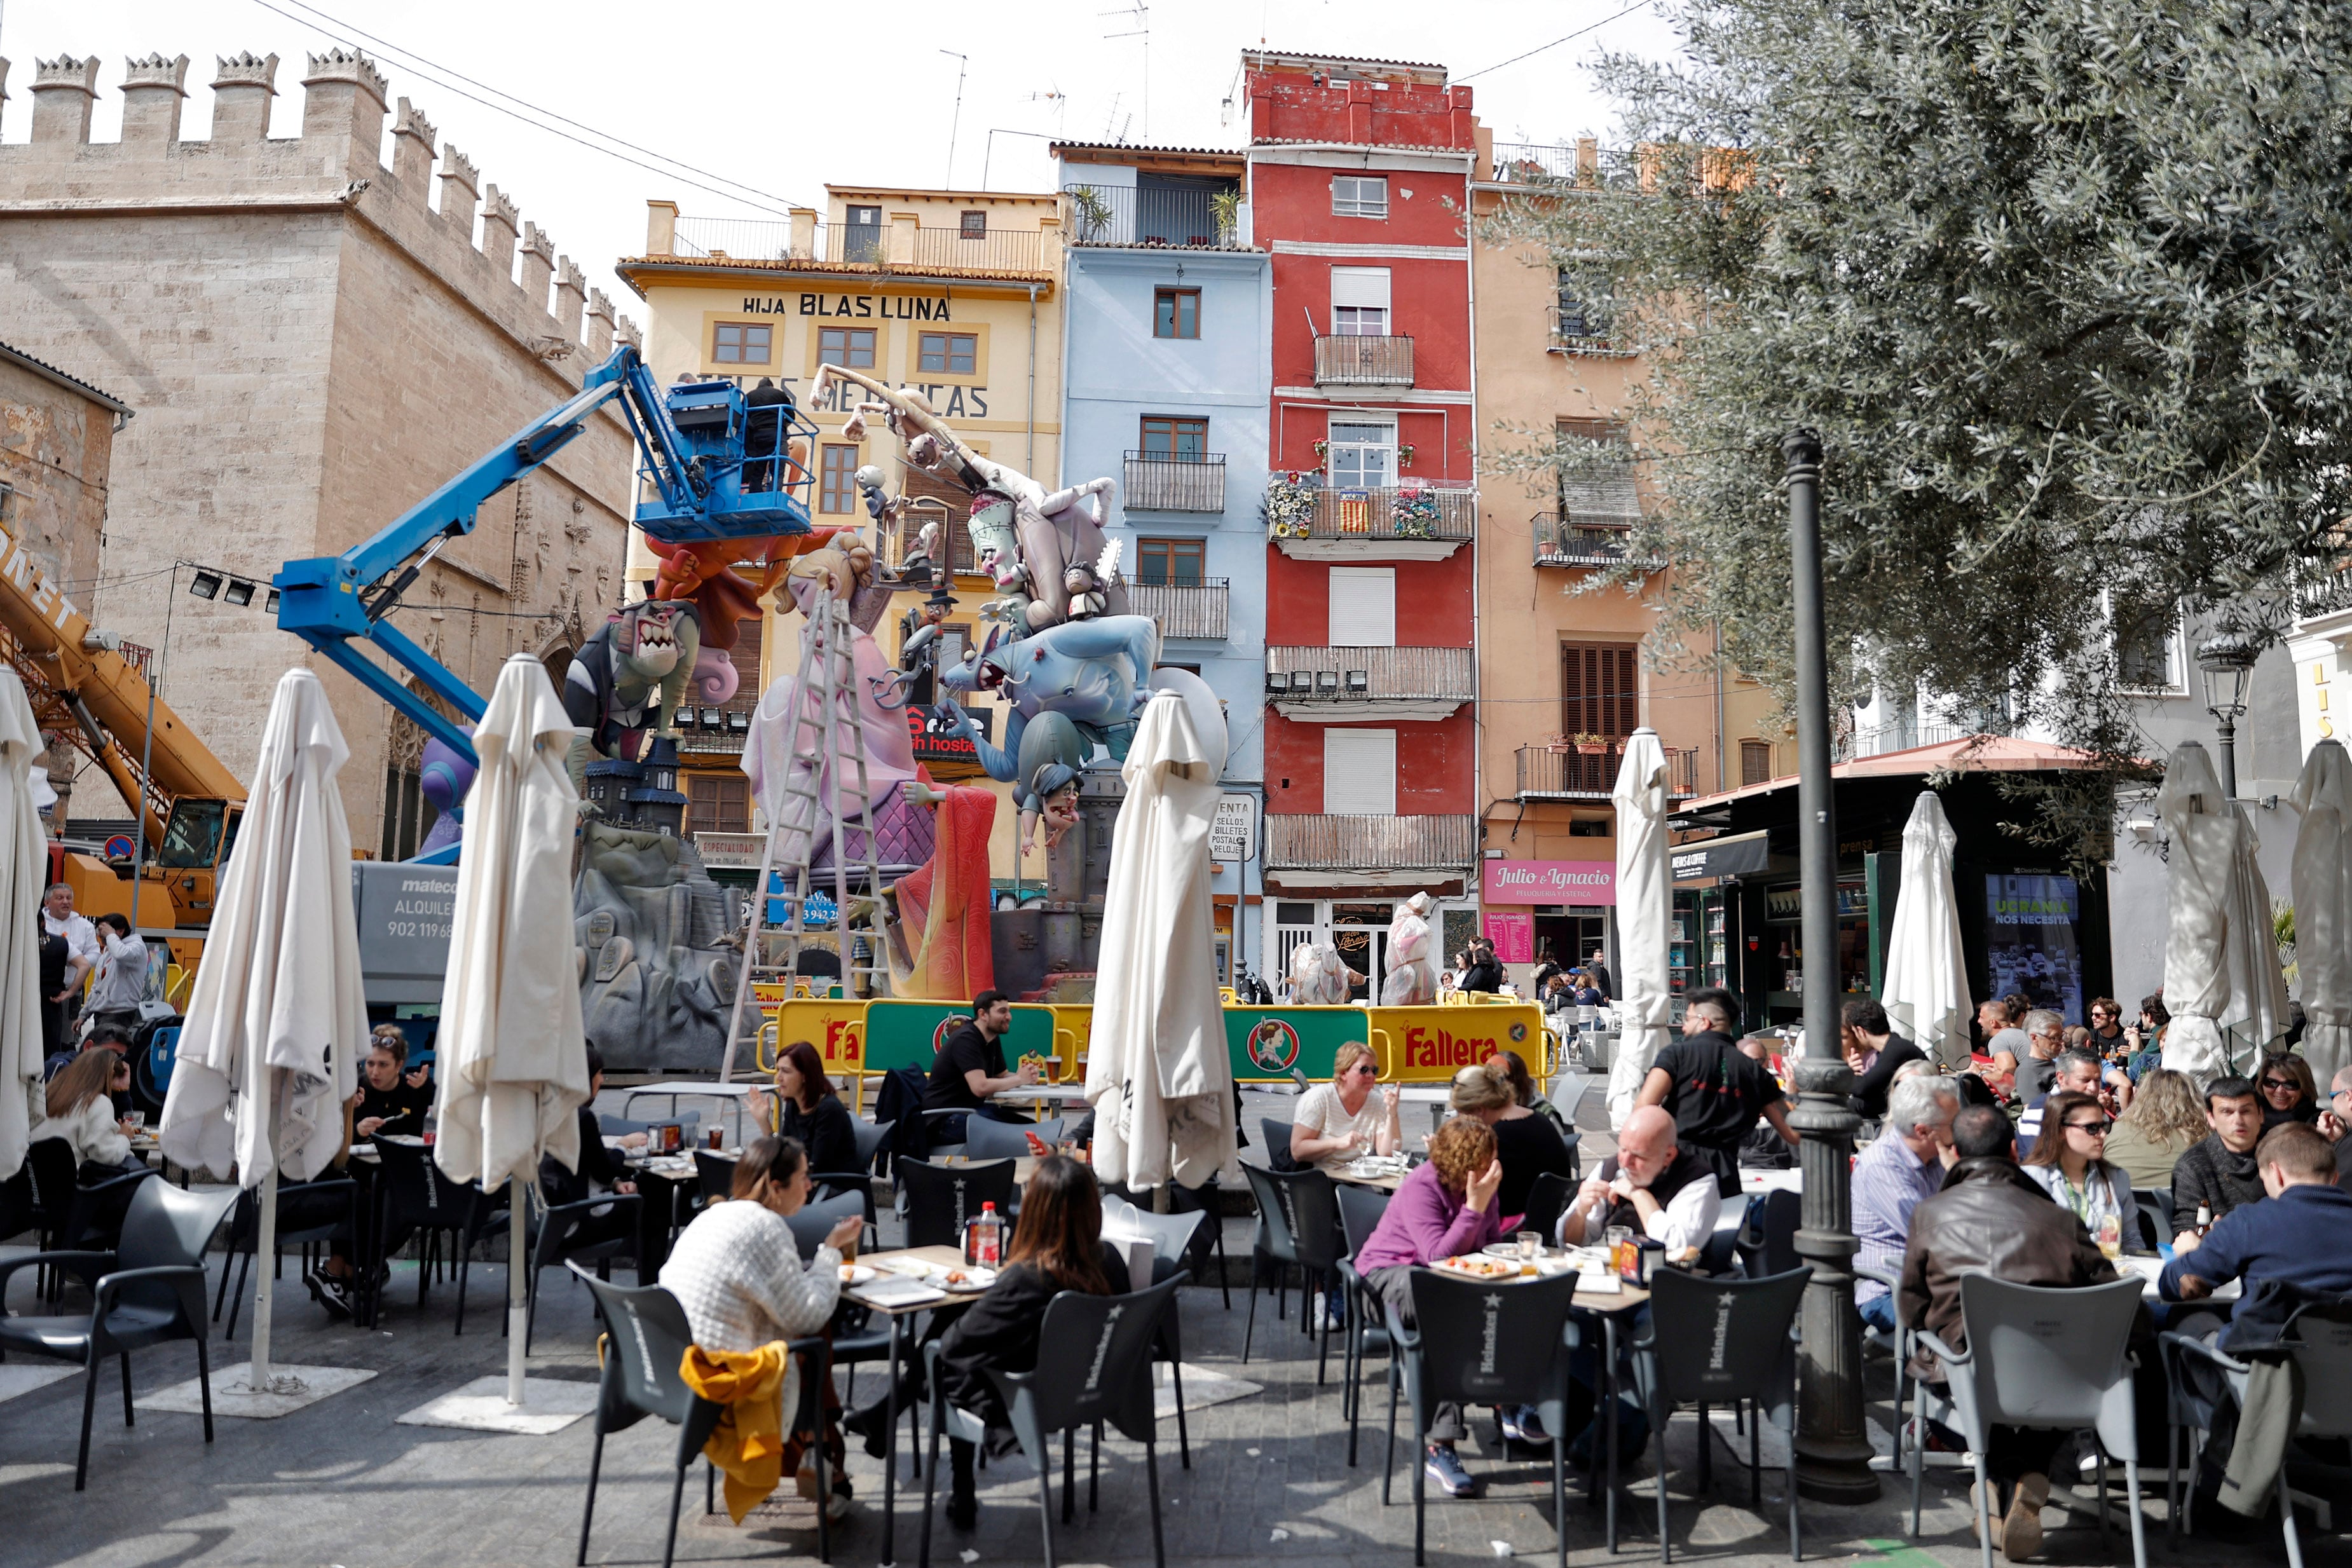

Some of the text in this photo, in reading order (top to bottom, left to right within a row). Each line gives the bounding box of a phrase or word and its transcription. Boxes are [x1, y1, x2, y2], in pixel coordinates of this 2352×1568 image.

[743, 294, 950, 321] HIJA BLAS LUNA
[650, 384, 674, 432] mateco
[1219, 803, 1248, 813] ENTA
[1215, 826, 1248, 835] BILLETES
[1217, 817, 1244, 826] SELLOS
[703, 842, 755, 853] ESPECIALIDAD
[1212, 836, 1245, 845] POSTAL
[1840, 839, 1873, 855] prensa
[1672, 852, 1707, 868] NEWS & COFFEE
[1495, 867, 1611, 889] Julio & Ignacio
[394, 900, 455, 915] ALQUILE
[1995, 900, 2070, 913] UCRANIA
[388, 921, 416, 936] 902
[419, 922, 437, 937] 119
[1995, 915, 2070, 925] NOS NECESITA
[1405, 1027, 1498, 1067] Fallera
[26, 1161, 40, 1205] Heineken
[426, 1166, 438, 1208] Heineken
[955, 1190, 964, 1236] Heineken
[1283, 1190, 1299, 1239] Heineken
[1480, 1309, 1498, 1374] Heineken
[1710, 1308, 1730, 1368] Heineken
[1084, 1321, 1116, 1390] Heineken
